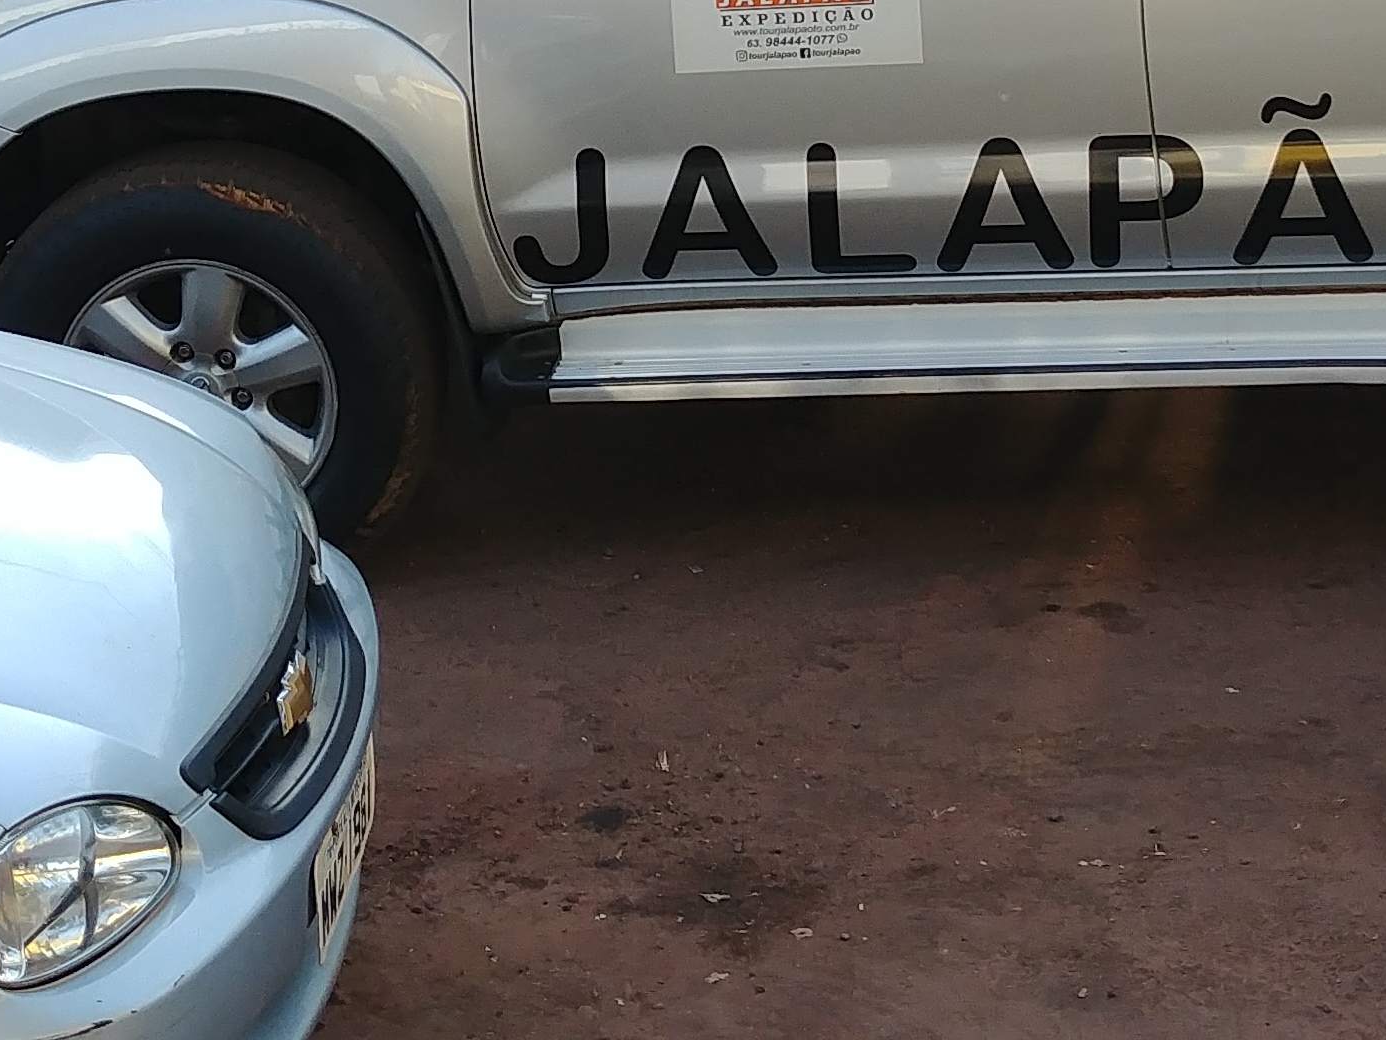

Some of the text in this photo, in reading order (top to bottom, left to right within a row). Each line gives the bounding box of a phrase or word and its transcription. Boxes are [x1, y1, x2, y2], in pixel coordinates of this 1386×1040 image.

[721, 7, 874, 27] EXPEDIÇÃO
[733, 23, 860, 37] www.tourjalapaoto.com.br
[765, 34, 835, 47] 98444-1077
[749, 48, 861, 60] tourjalapao tourjalapao
